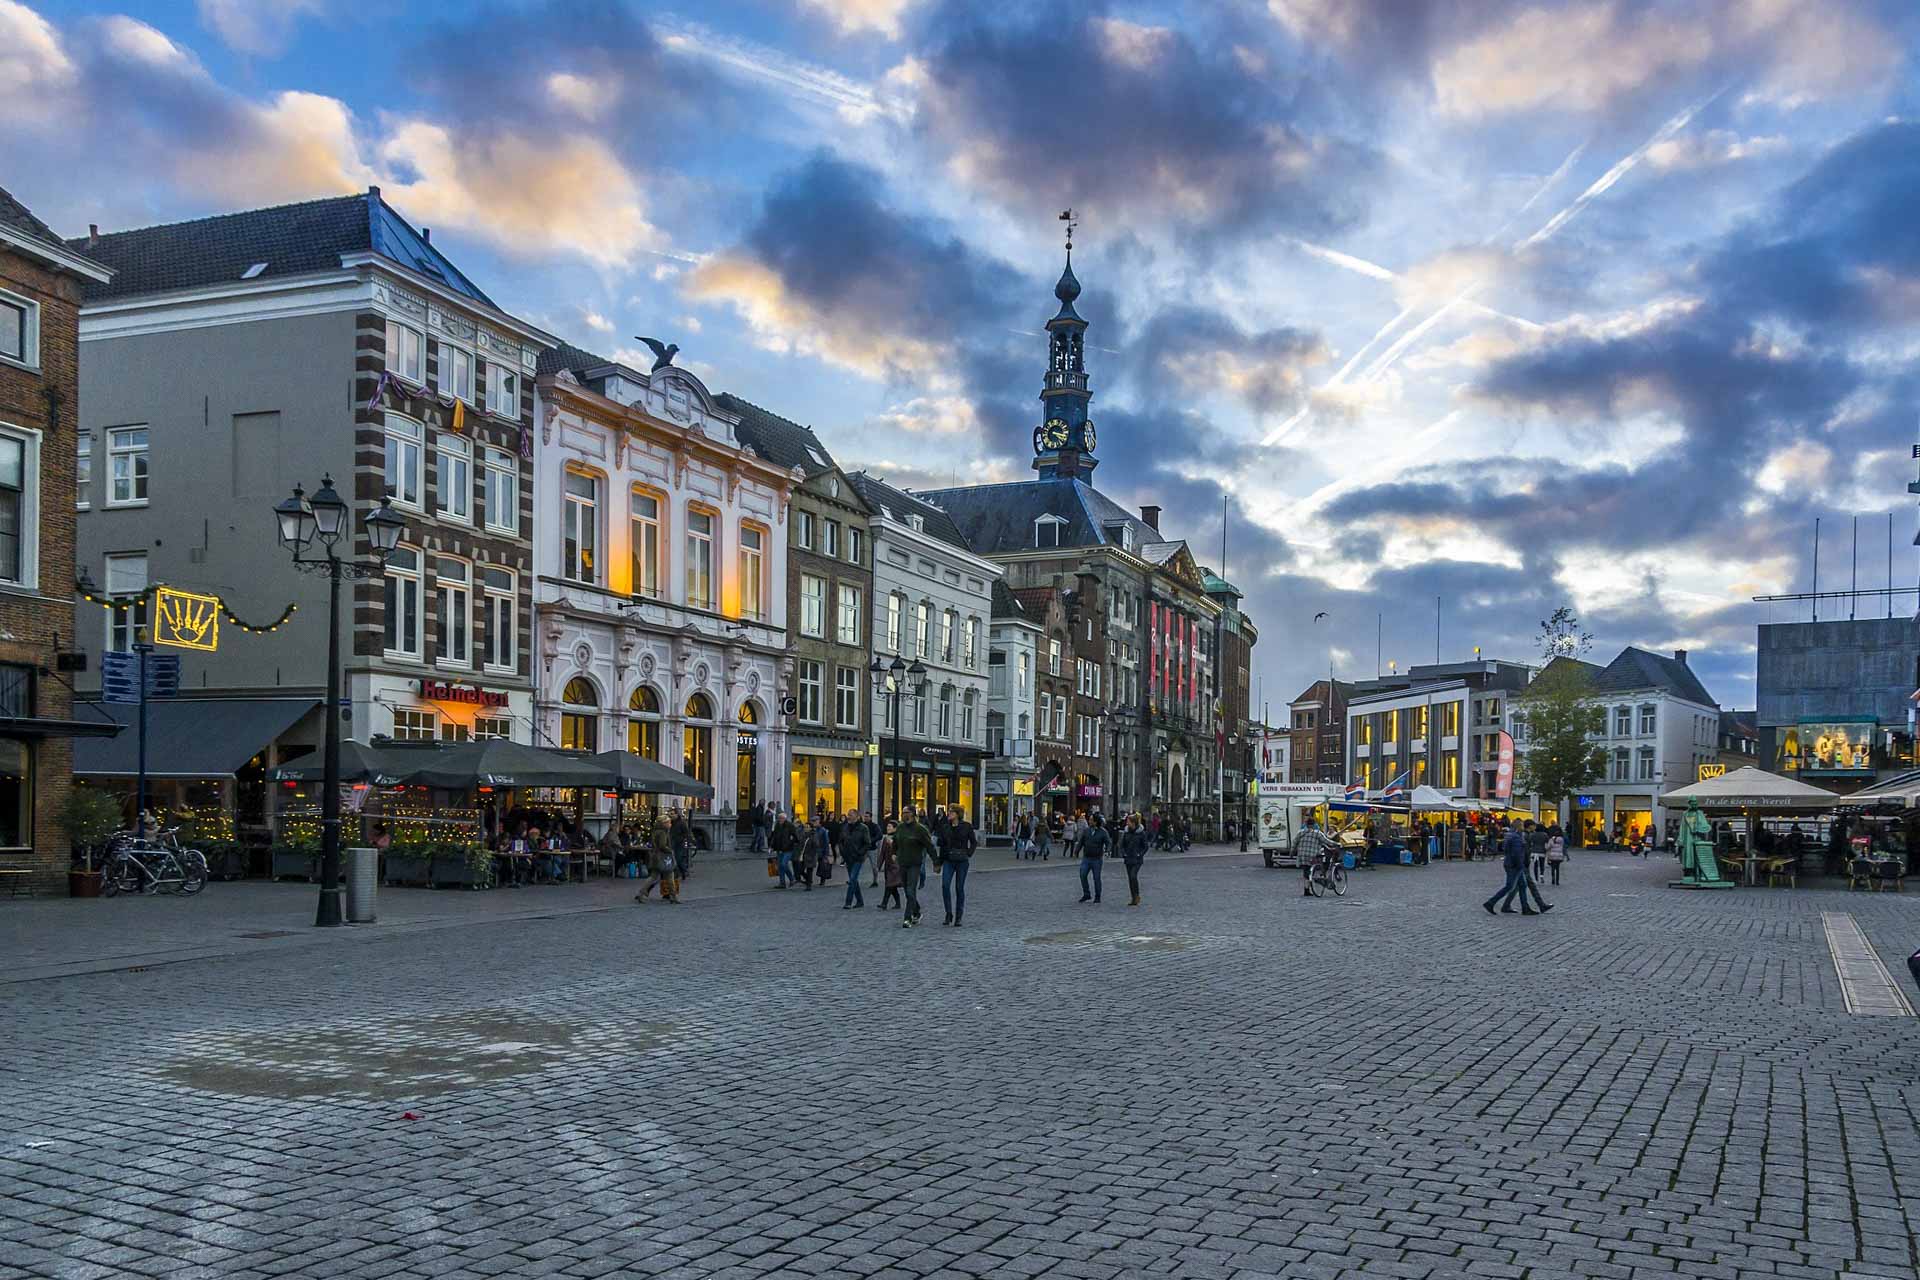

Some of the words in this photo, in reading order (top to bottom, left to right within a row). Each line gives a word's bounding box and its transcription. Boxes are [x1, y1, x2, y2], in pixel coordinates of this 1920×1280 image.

[423, 677, 509, 707] Heineken
[783, 697, 796, 715] C
[1704, 798, 1715, 806] In
[1717, 797, 1728, 805] de
